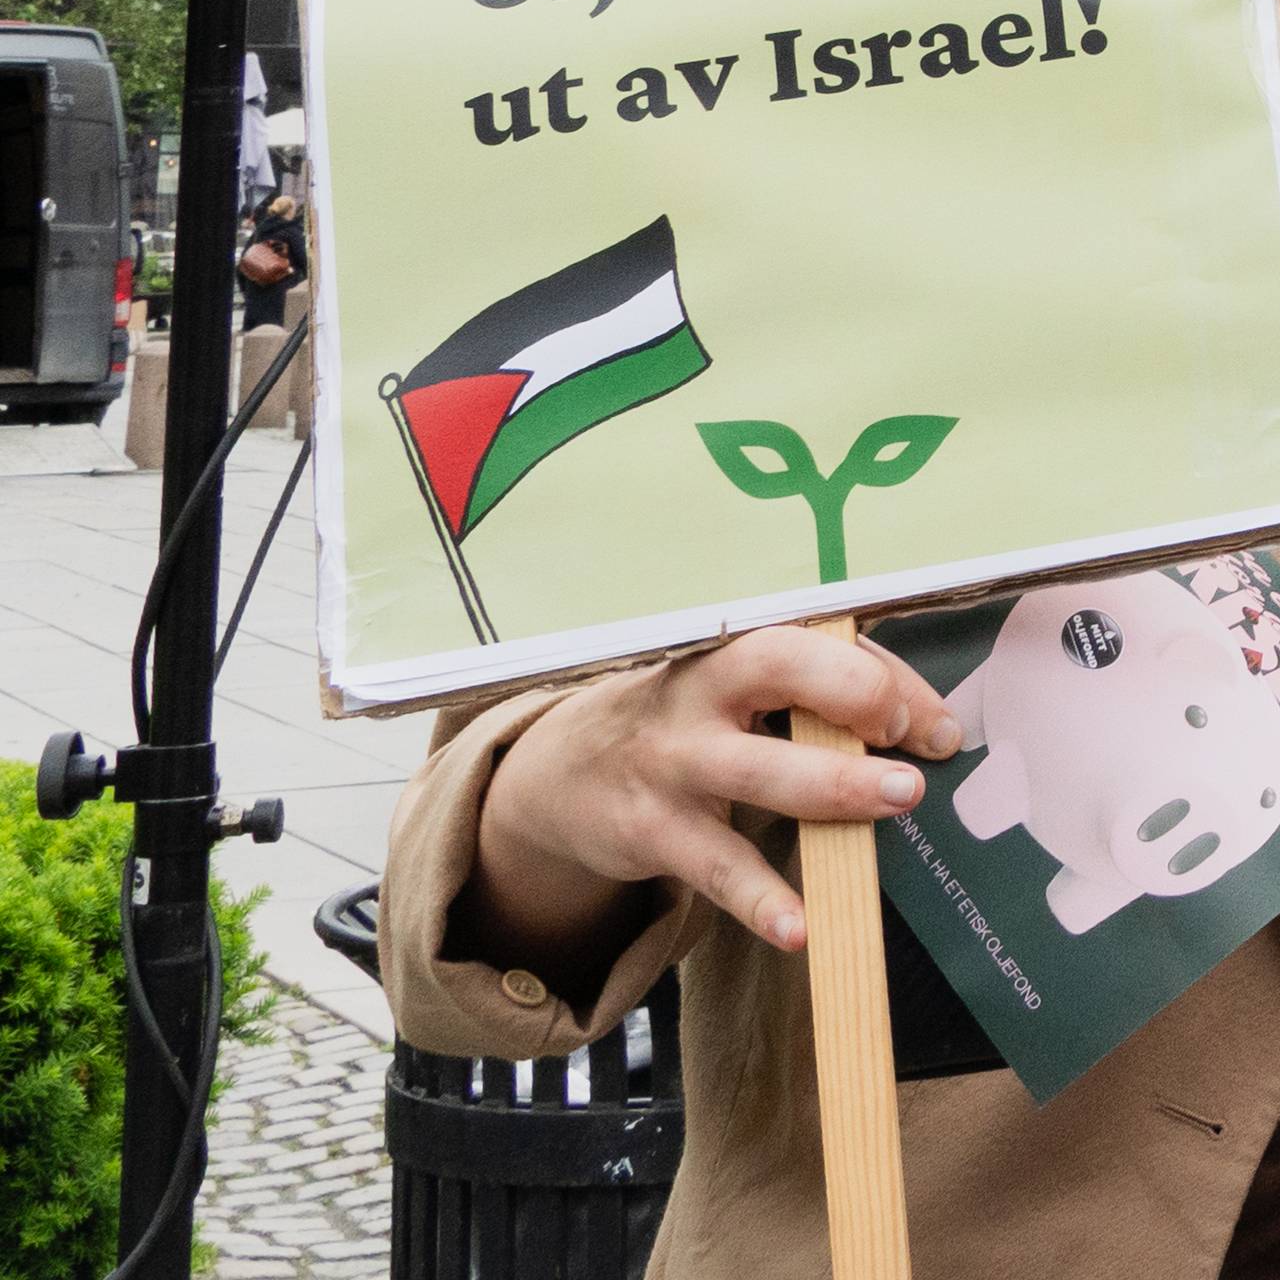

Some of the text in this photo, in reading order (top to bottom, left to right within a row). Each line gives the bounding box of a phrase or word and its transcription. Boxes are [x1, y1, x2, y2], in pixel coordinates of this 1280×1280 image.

[464, 67, 588, 146] ut
[615, 54, 740, 122] av
[1073, 614, 1098, 669] OLJEFOND
[1090, 623, 1108, 652] MITT
[917, 837, 936, 865] VIL
[928, 858, 952, 886] HA
[944, 879, 967, 903] ET
[957, 897, 995, 942] ETISK
[986, 936, 1043, 1011] OLJEFOND
